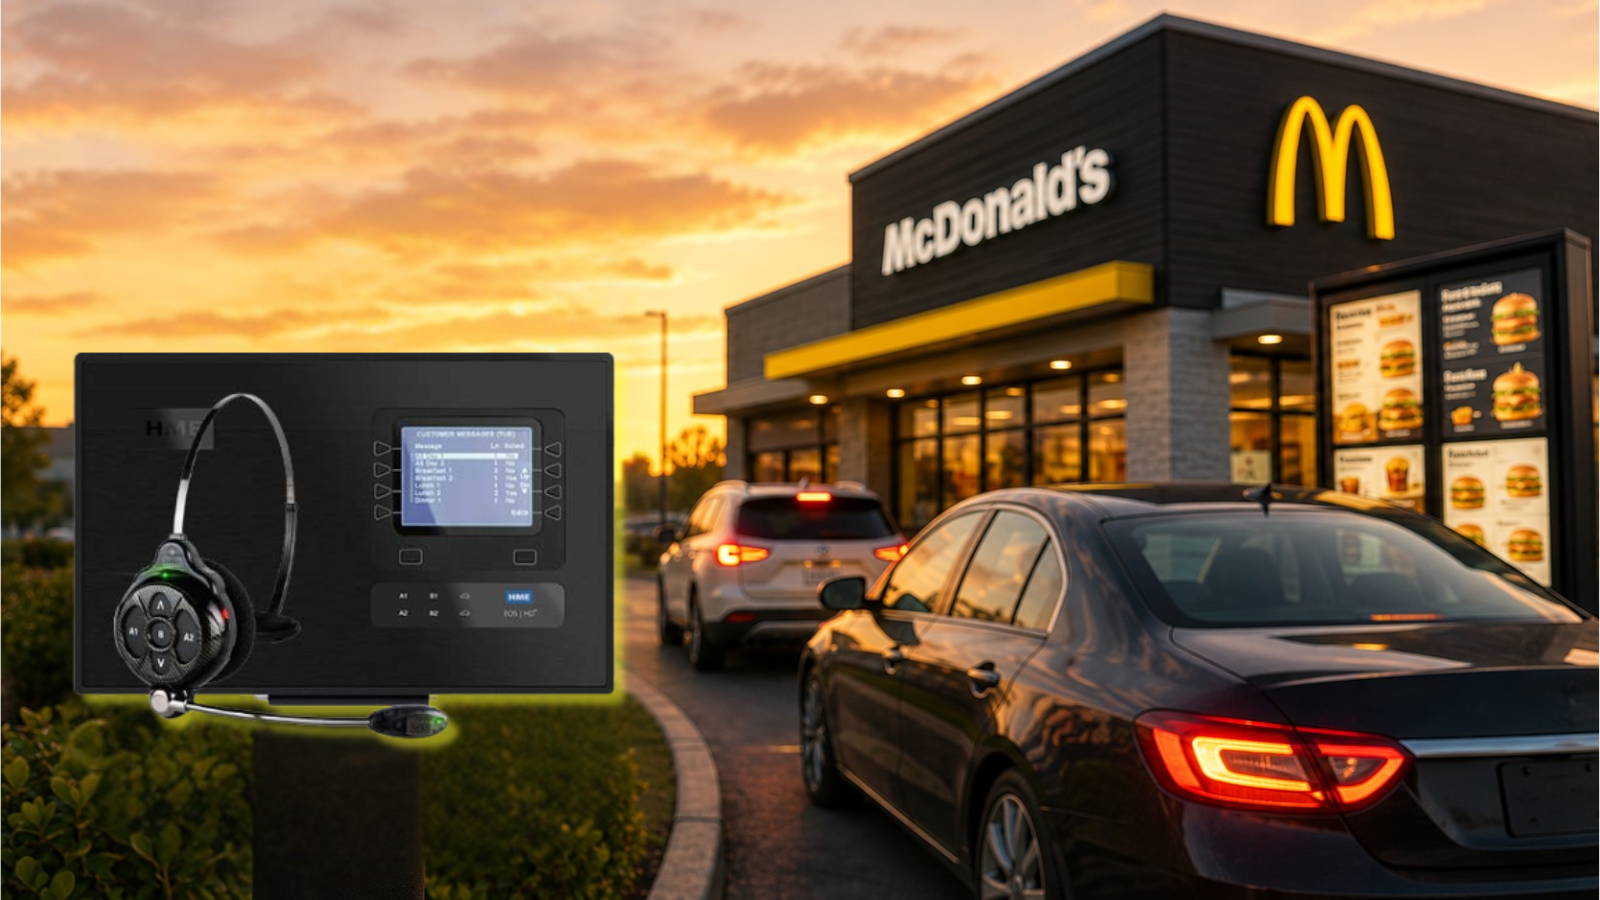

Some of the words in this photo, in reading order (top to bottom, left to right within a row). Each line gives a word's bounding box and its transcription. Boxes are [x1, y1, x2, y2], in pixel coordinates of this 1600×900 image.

[881, 145, 1112, 276] McDonald's
[508, 593, 531, 601] HME
[157, 630, 164, 638] B
[183, 633, 195, 642] A2
